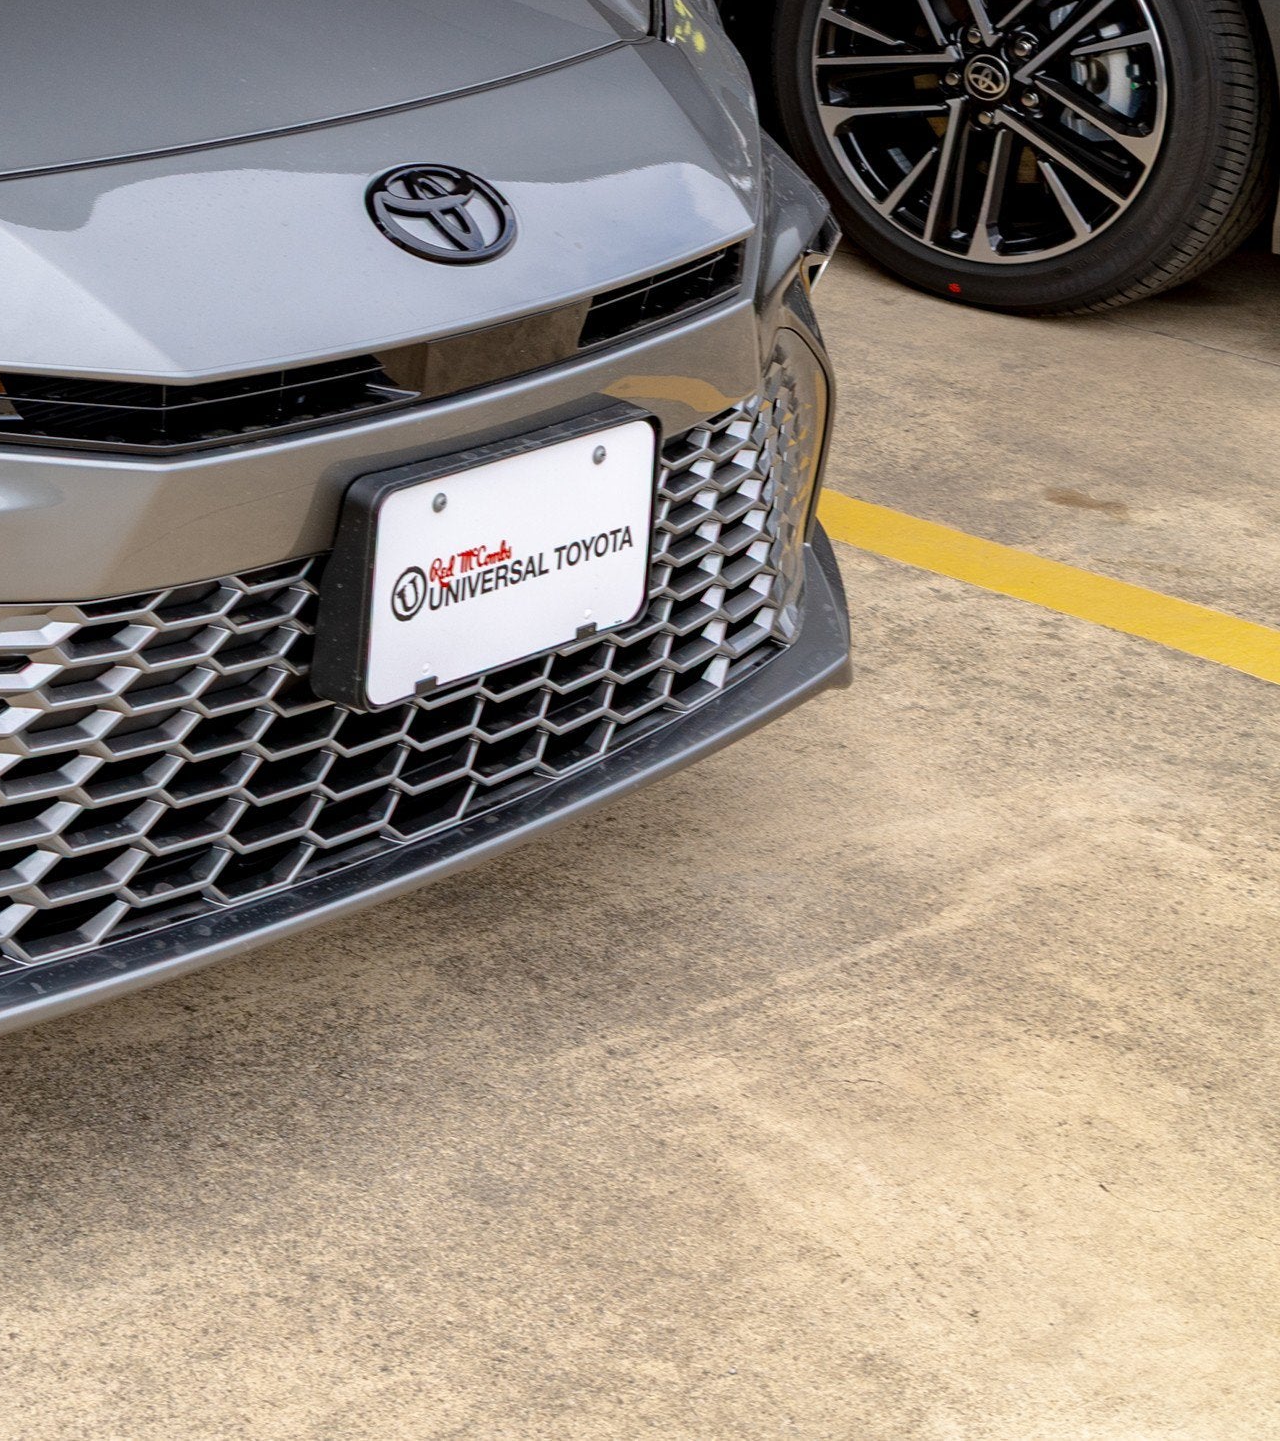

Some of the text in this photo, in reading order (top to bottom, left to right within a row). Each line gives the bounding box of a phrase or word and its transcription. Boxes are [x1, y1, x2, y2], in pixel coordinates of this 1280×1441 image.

[429, 525, 633, 611] UNIVERSAL TOYOTA
[429, 555, 455, 587] Red
